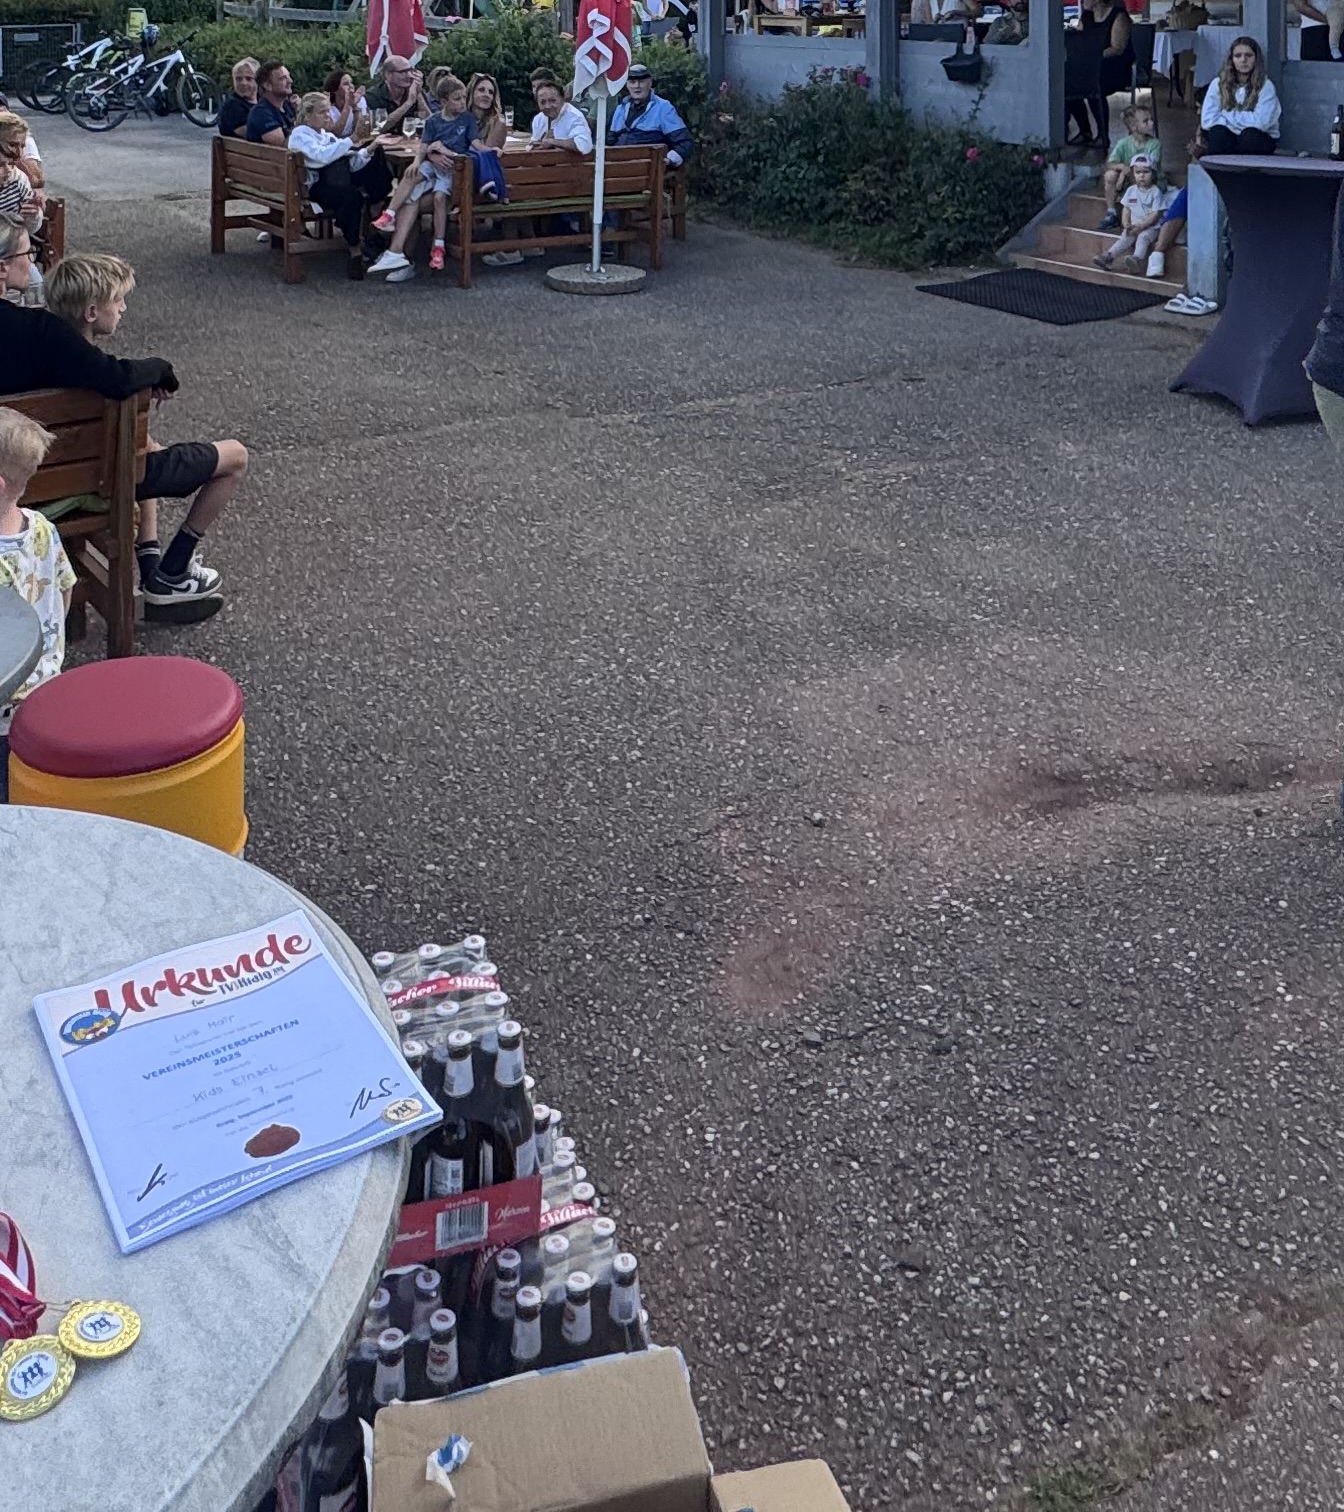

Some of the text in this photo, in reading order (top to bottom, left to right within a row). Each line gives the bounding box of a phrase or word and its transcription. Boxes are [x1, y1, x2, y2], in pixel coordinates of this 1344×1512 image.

[94, 934, 312, 1017] Urkunde
[142, 1019, 300, 1081] VEREINSMEISTERSCHAFTEN
[213, 1051, 242, 1066] 2025
